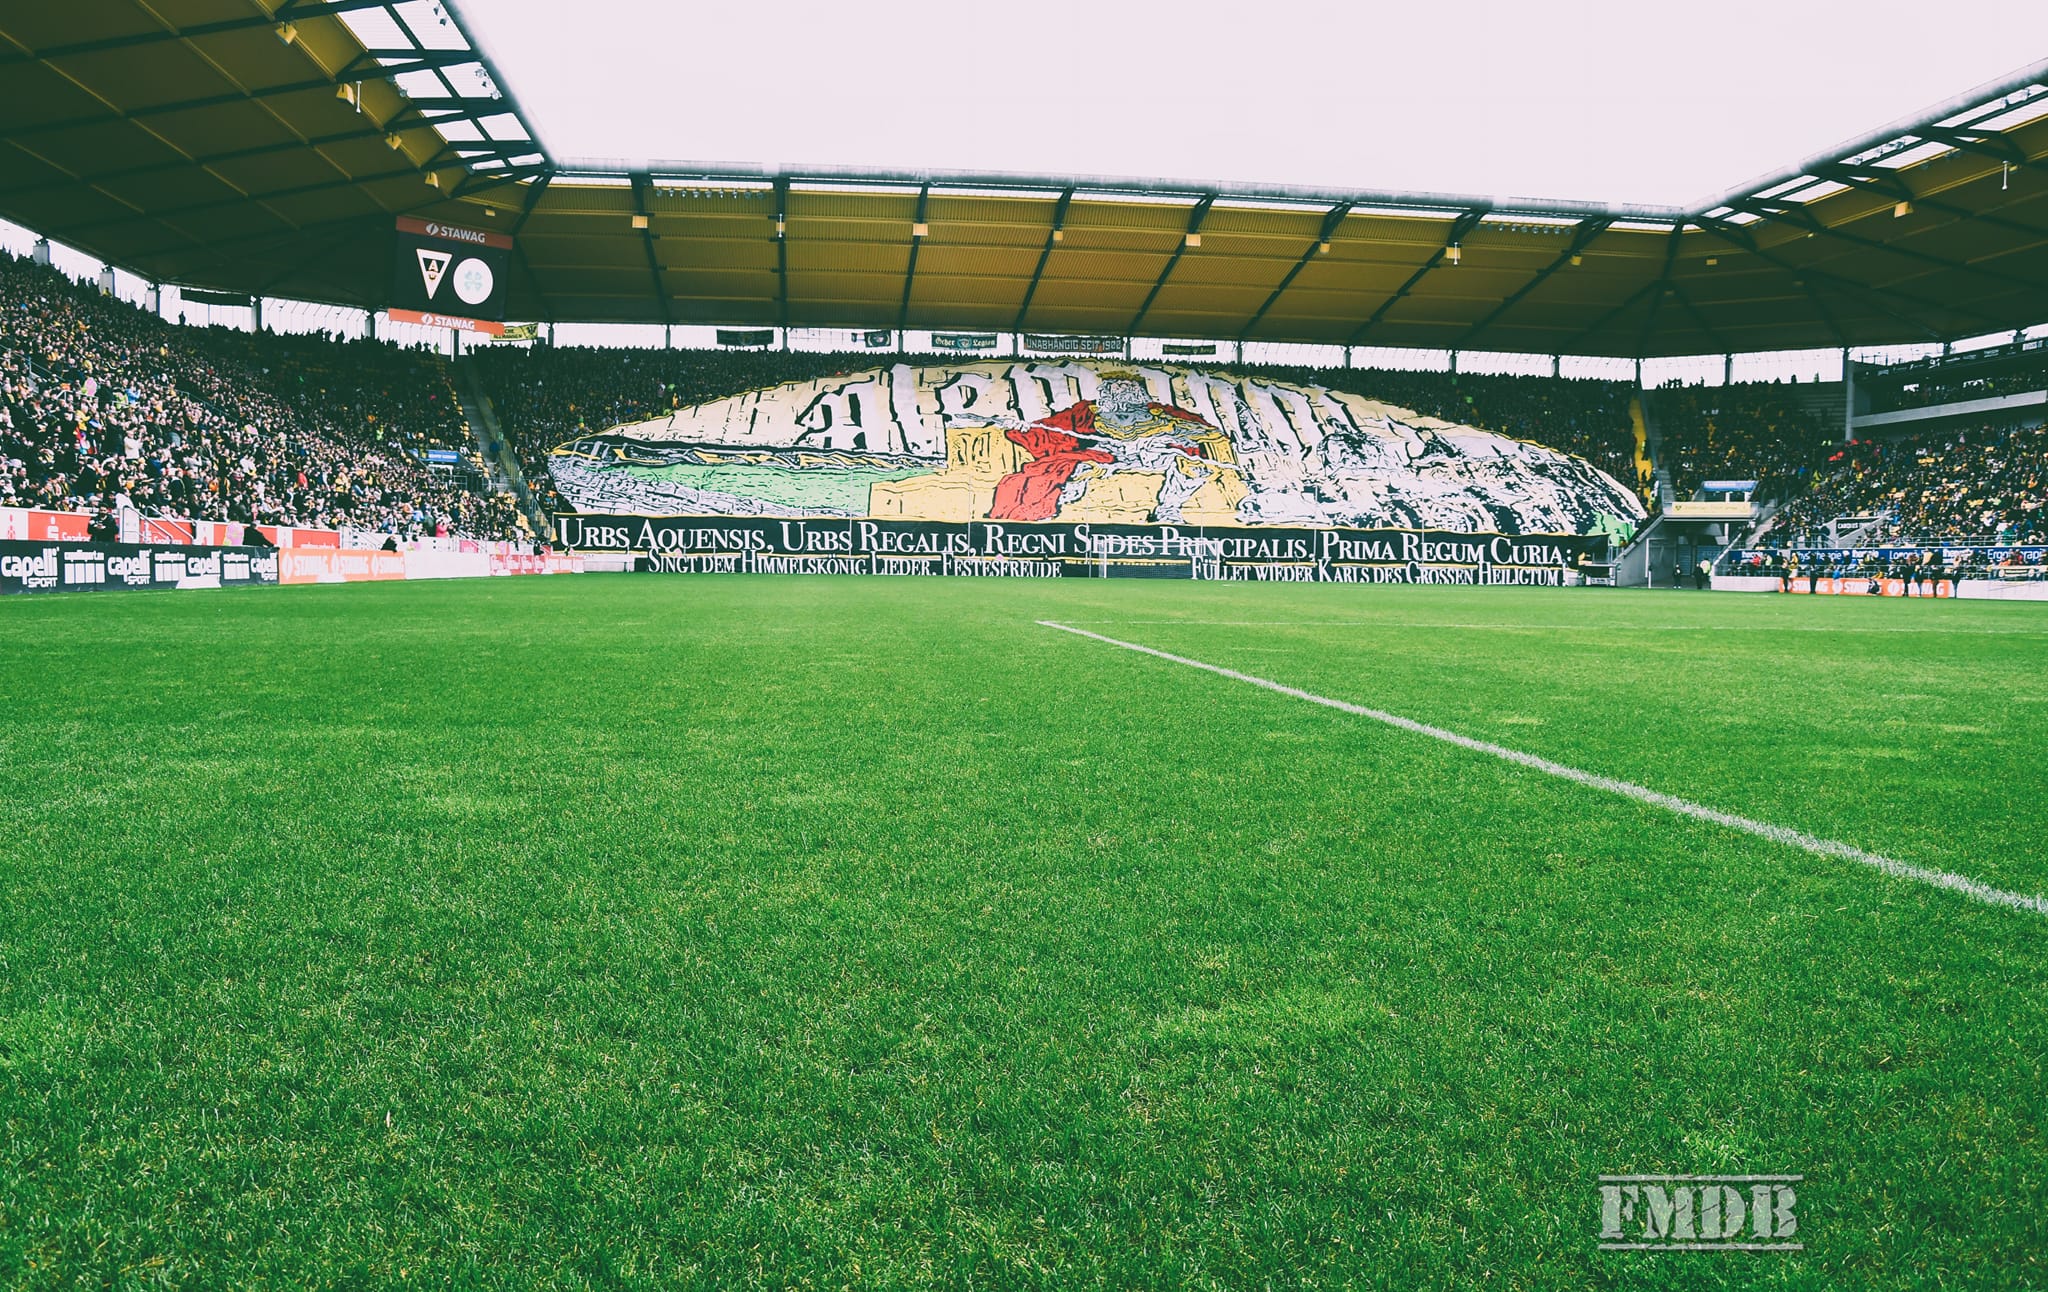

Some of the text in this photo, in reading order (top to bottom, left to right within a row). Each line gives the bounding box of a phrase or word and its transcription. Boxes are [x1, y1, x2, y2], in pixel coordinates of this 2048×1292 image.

[441, 226, 485, 243] STAWAG
[434, 316, 475, 329] STAWAG
[1026, 338, 1079, 351] UNABHÄNGIG
[1081, 339, 1100, 351] SEIT
[558, 518, 630, 548] URBS
[633, 518, 774, 554] AQUENSIS,
[779, 521, 853, 552] URBS
[857, 521, 977, 557] REGALIS,
[983, 523, 1066, 554] REGNI
[1074, 524, 1155, 556] SEDES
[1320, 531, 1396, 561] PRIMA
[1400, 532, 1486, 563] REGUM
[1, 548, 58, 585] capelli
[107, 549, 151, 582] capelli
[187, 551, 221, 576] capelli
[648, 547, 698, 573] SINGT
[701, 555, 736, 573] DEM
[741, 549, 868, 575] HIMMELSKÖNIG
[941, 552, 1062, 577] FESTESFREUDE
[1254, 565, 1315, 582] WIEDER
[1317, 558, 1370, 583] KARLS
[1373, 567, 1403, 583] DES
[1405, 561, 1475, 585] GROSSEN
[1476, 560, 1559, 586] HEILIGTUM
[28, 577, 58, 588] SPORT
[127, 575, 151, 585] SPORT
